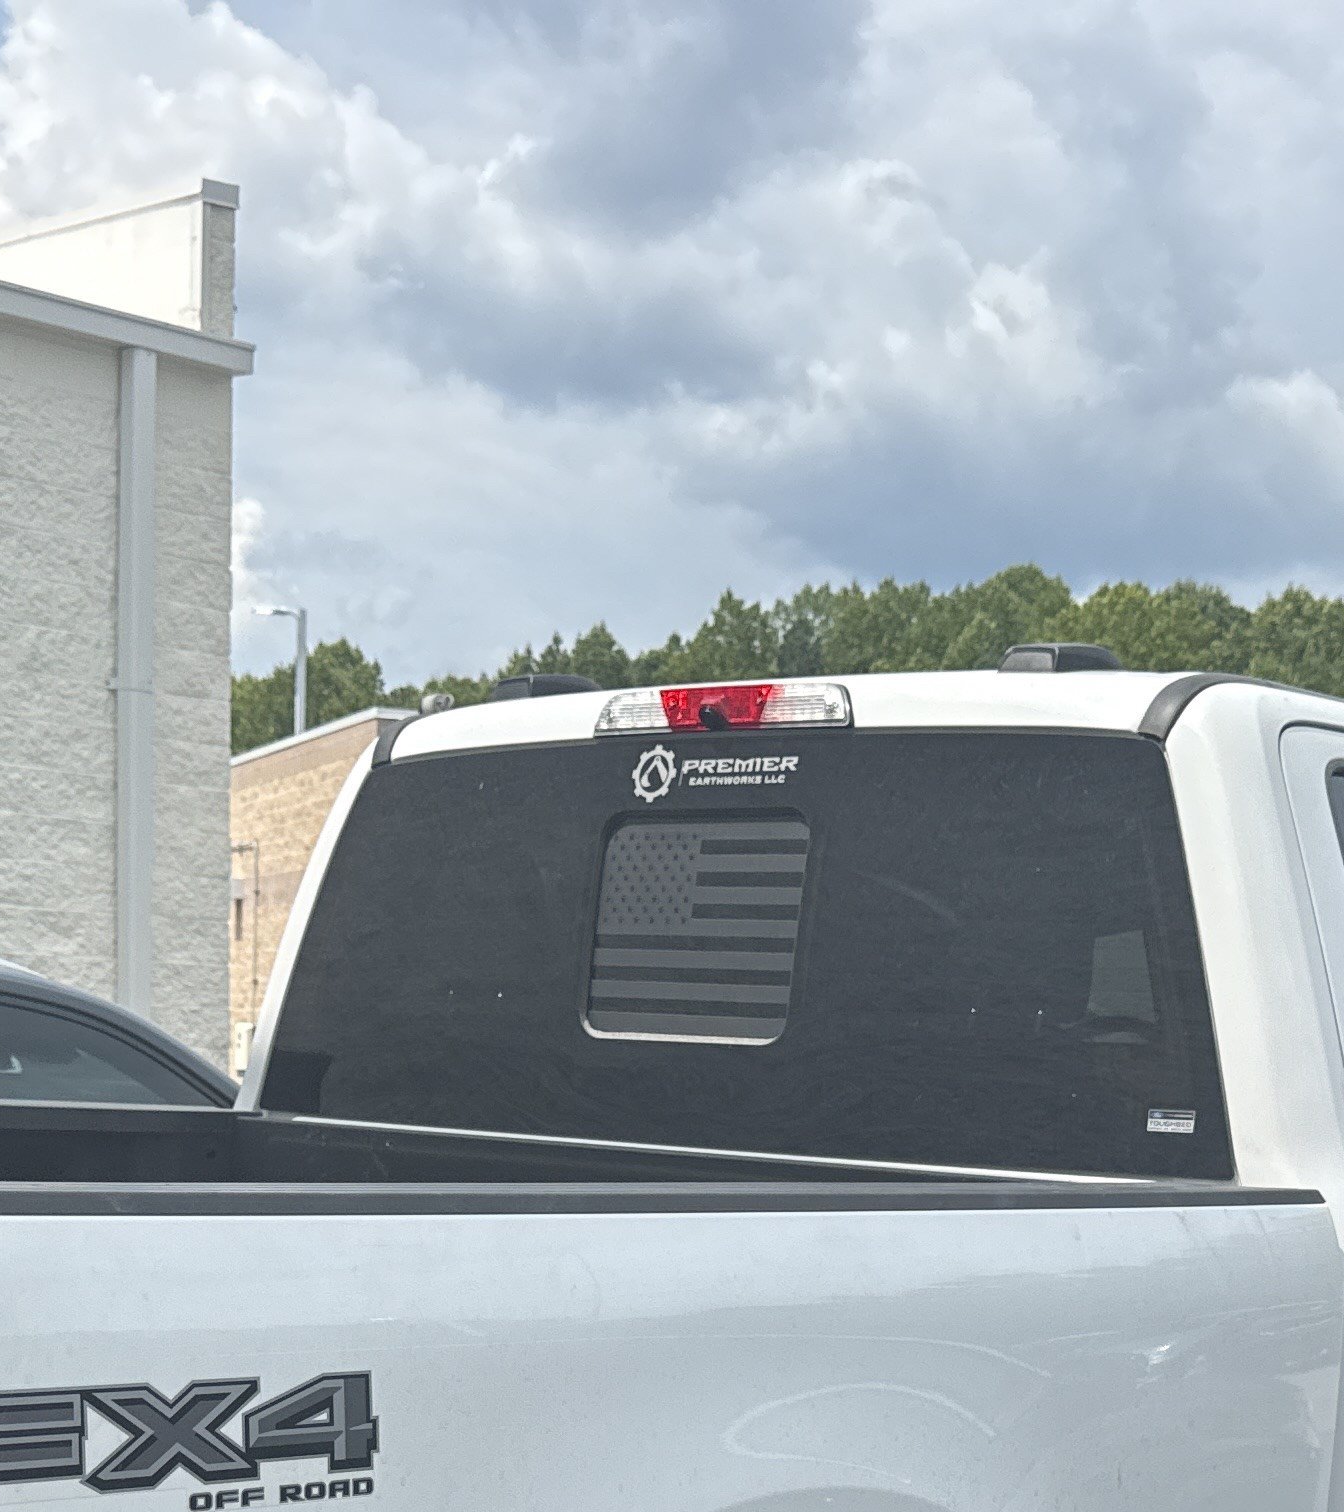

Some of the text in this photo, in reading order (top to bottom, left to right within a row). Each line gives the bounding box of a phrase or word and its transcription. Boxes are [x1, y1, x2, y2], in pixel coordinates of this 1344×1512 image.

[682, 756, 799, 774] PREMIER
[689, 774, 786, 786] EARTHWORKS LLC
[188, 1476, 375, 1512] OFF ROAD
